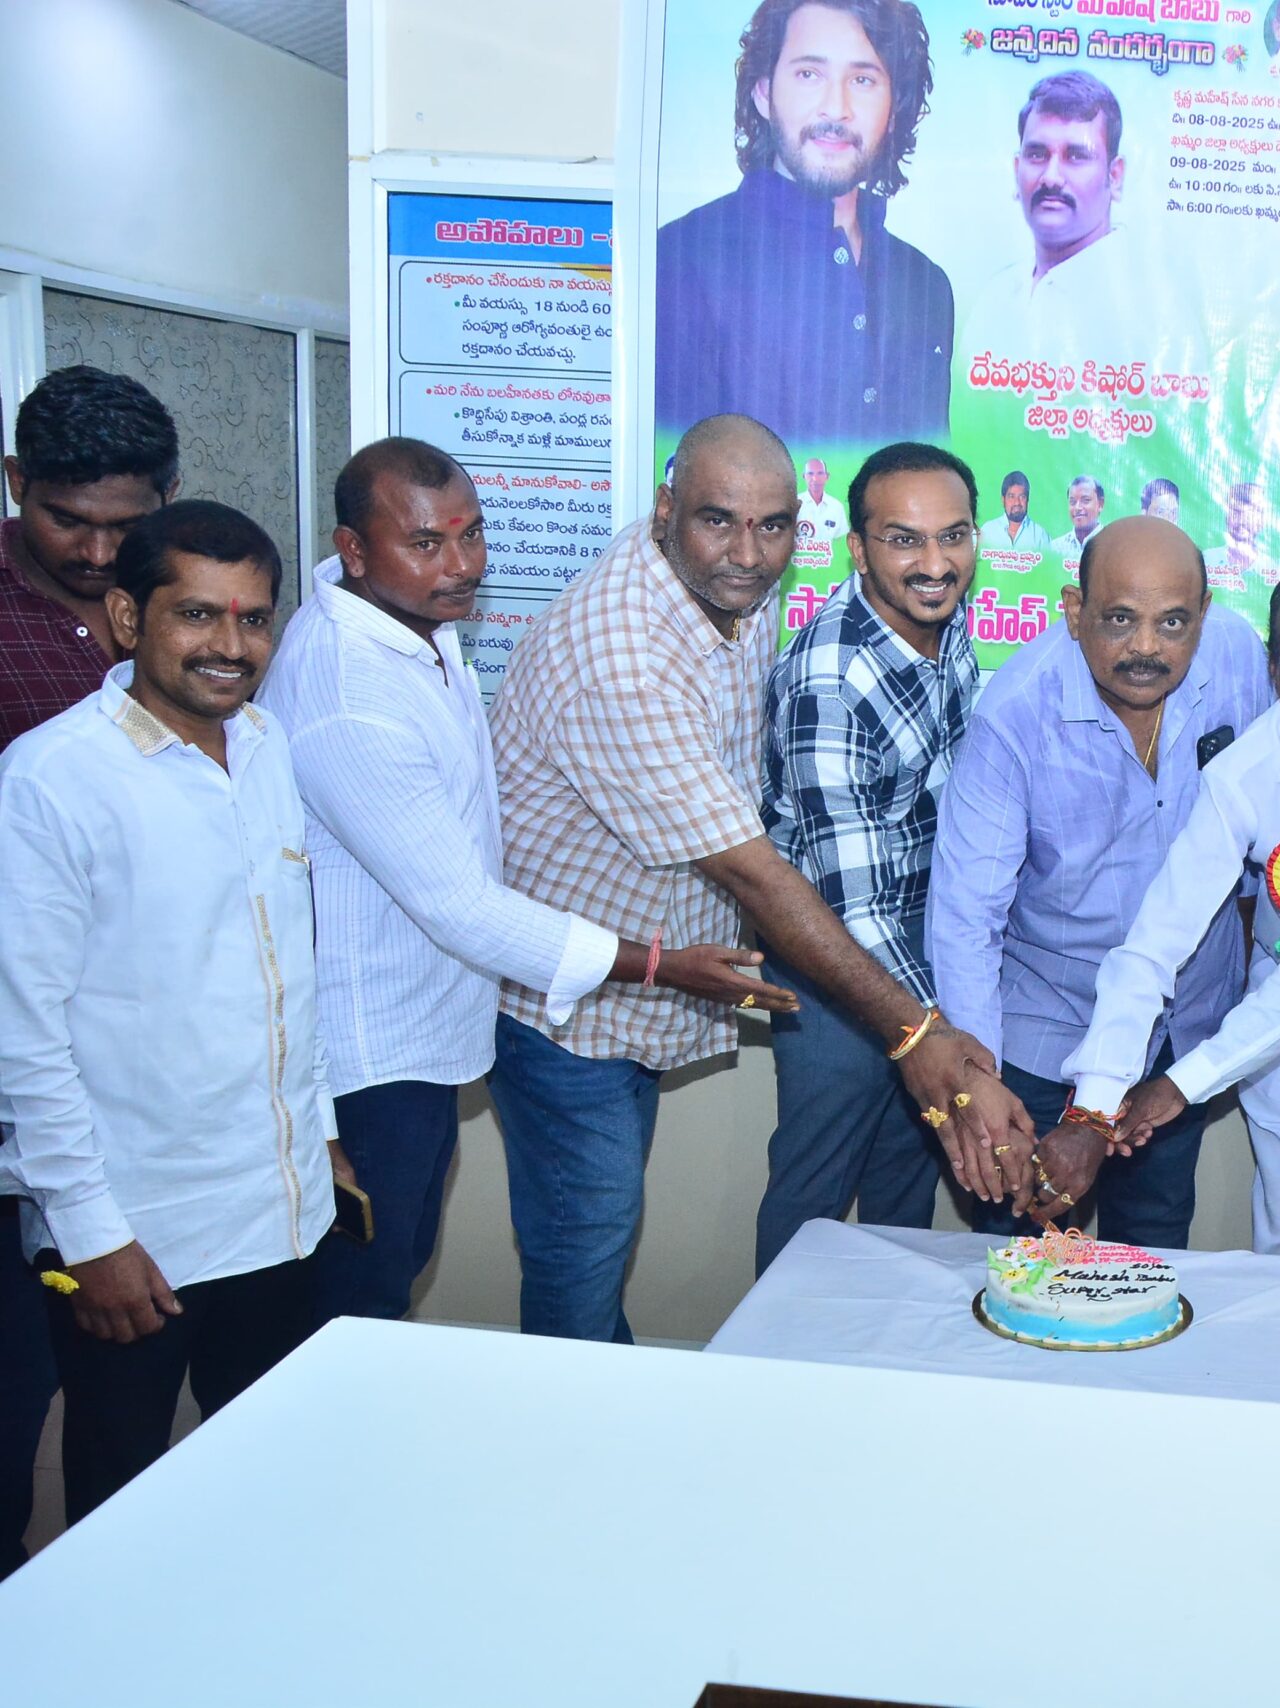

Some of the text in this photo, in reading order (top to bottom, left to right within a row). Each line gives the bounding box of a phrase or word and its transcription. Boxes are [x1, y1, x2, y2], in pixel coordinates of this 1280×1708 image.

[1225, 12, 1251, 24] గారి
[991, 25, 1215, 75] జన్మదిన సందర్భంగా
[1188, 114, 1264, 129] 08-08-2025
[1170, 135, 1202, 151] ఖమ్మం
[1170, 156, 1246, 172] 09-08-2025
[1186, 202, 1213, 213] 6:00
[433, 272, 484, 289] రక్తదానం
[549, 280, 564, 290] నా
[462, 295, 611, 316] మీ వయస్సు 18 నుండి 60
[462, 320, 509, 339] సంపూర్ణ
[462, 342, 512, 359] రక్తదానం
[969, 351, 1209, 401] దేవభక్తుని కిషోర్ బాబు
[460, 383, 484, 398] నేను
[1028, 406, 1068, 435] జిల్లా
[472, 473, 510, 491] నులన్నీ
[478, 497, 564, 512] డునెలలకోసారి
[568, 499, 594, 514] మీరు
[508, 517, 543, 533] కేవలం
[546, 521, 578, 535] కొంత
[514, 540, 577, 557] చేయడానికి
[580, 547, 589, 558] 8
[500, 563, 550, 577] సమయం
[487, 612, 522, 628] సన్నగా
[462, 634, 513, 651] మీ బరువు
